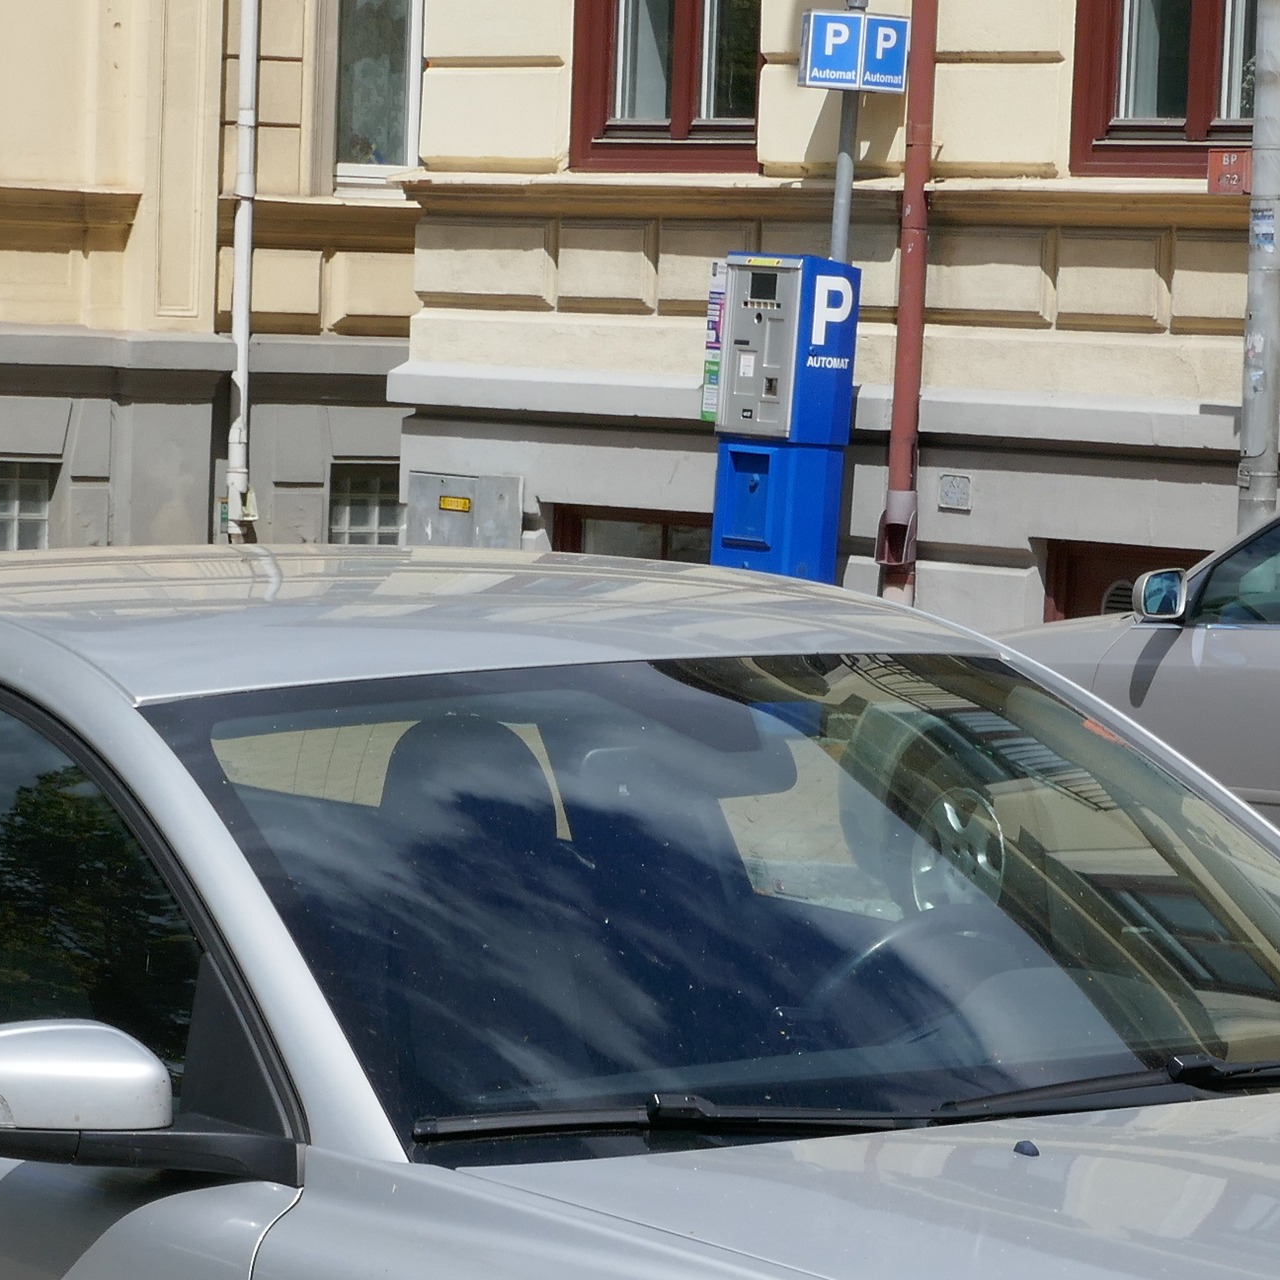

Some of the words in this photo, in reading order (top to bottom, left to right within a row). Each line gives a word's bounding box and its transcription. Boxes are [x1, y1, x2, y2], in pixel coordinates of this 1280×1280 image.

[825, 22, 850, 56] P
[876, 26, 897, 60] P
[811, 67, 856, 80] Automat
[864, 71, 902, 84] Automat
[1222, 153, 1237, 165] BP
[812, 275, 853, 346] P
[807, 356, 849, 370] AUTOMAT
